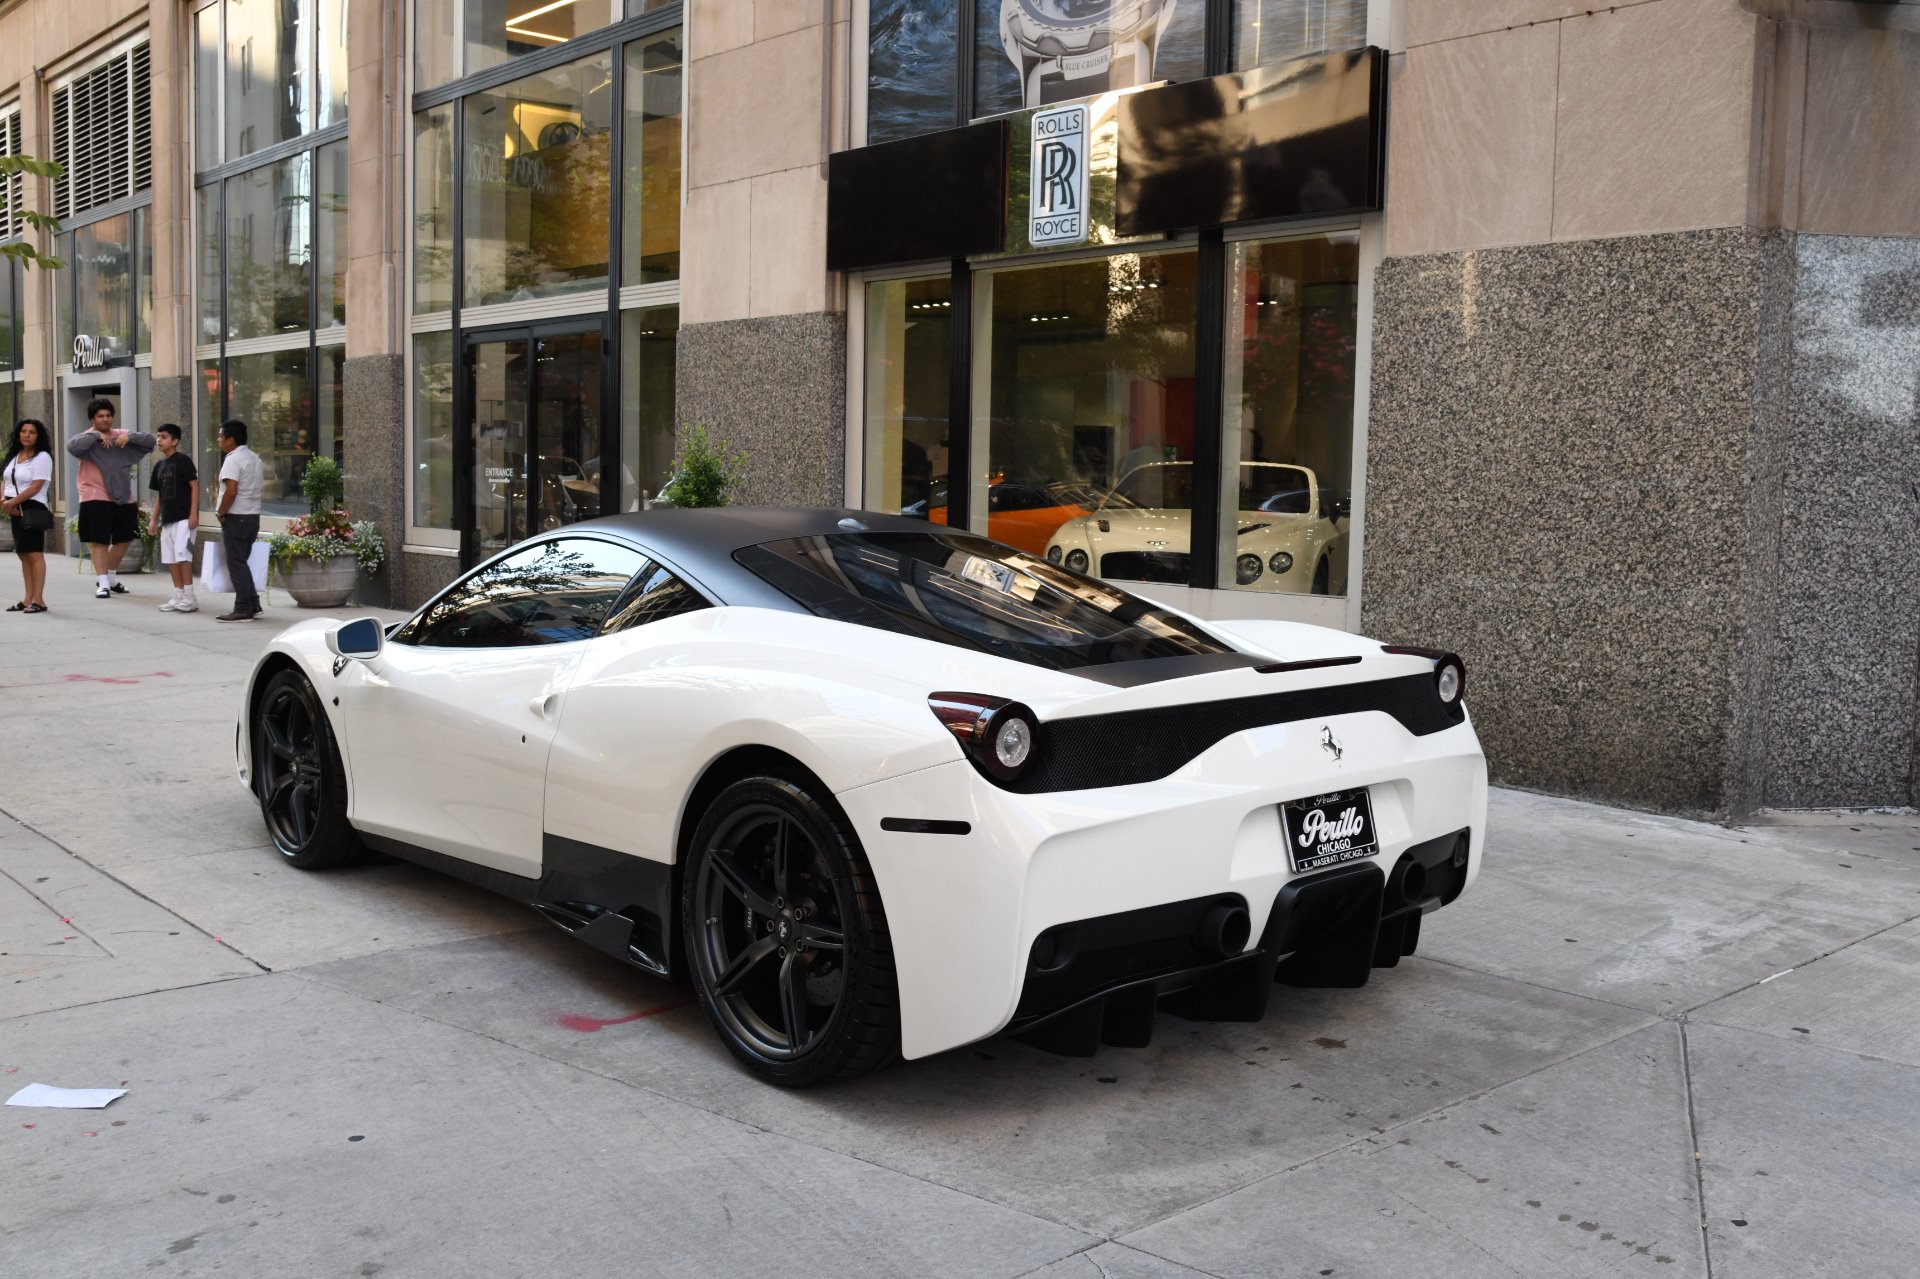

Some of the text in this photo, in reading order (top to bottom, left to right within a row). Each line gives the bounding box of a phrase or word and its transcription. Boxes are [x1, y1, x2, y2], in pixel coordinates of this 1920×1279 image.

[1064, 55, 1108, 71] BLUE CRUISER
[1038, 114, 1080, 135] ROLLS
[1039, 141, 1077, 213] RR
[1035, 217, 1077, 237] ROYCE
[73, 334, 104, 369] Perillo
[485, 467, 514, 477] ENTRANCE
[1314, 793, 1341, 806] Perillo
[1298, 806, 1364, 848] Perillo
[1316, 838, 1351, 855] CHICAGO
[1312, 854, 1339, 867] MASERATI
[1340, 848, 1363, 861] CHICAGO
